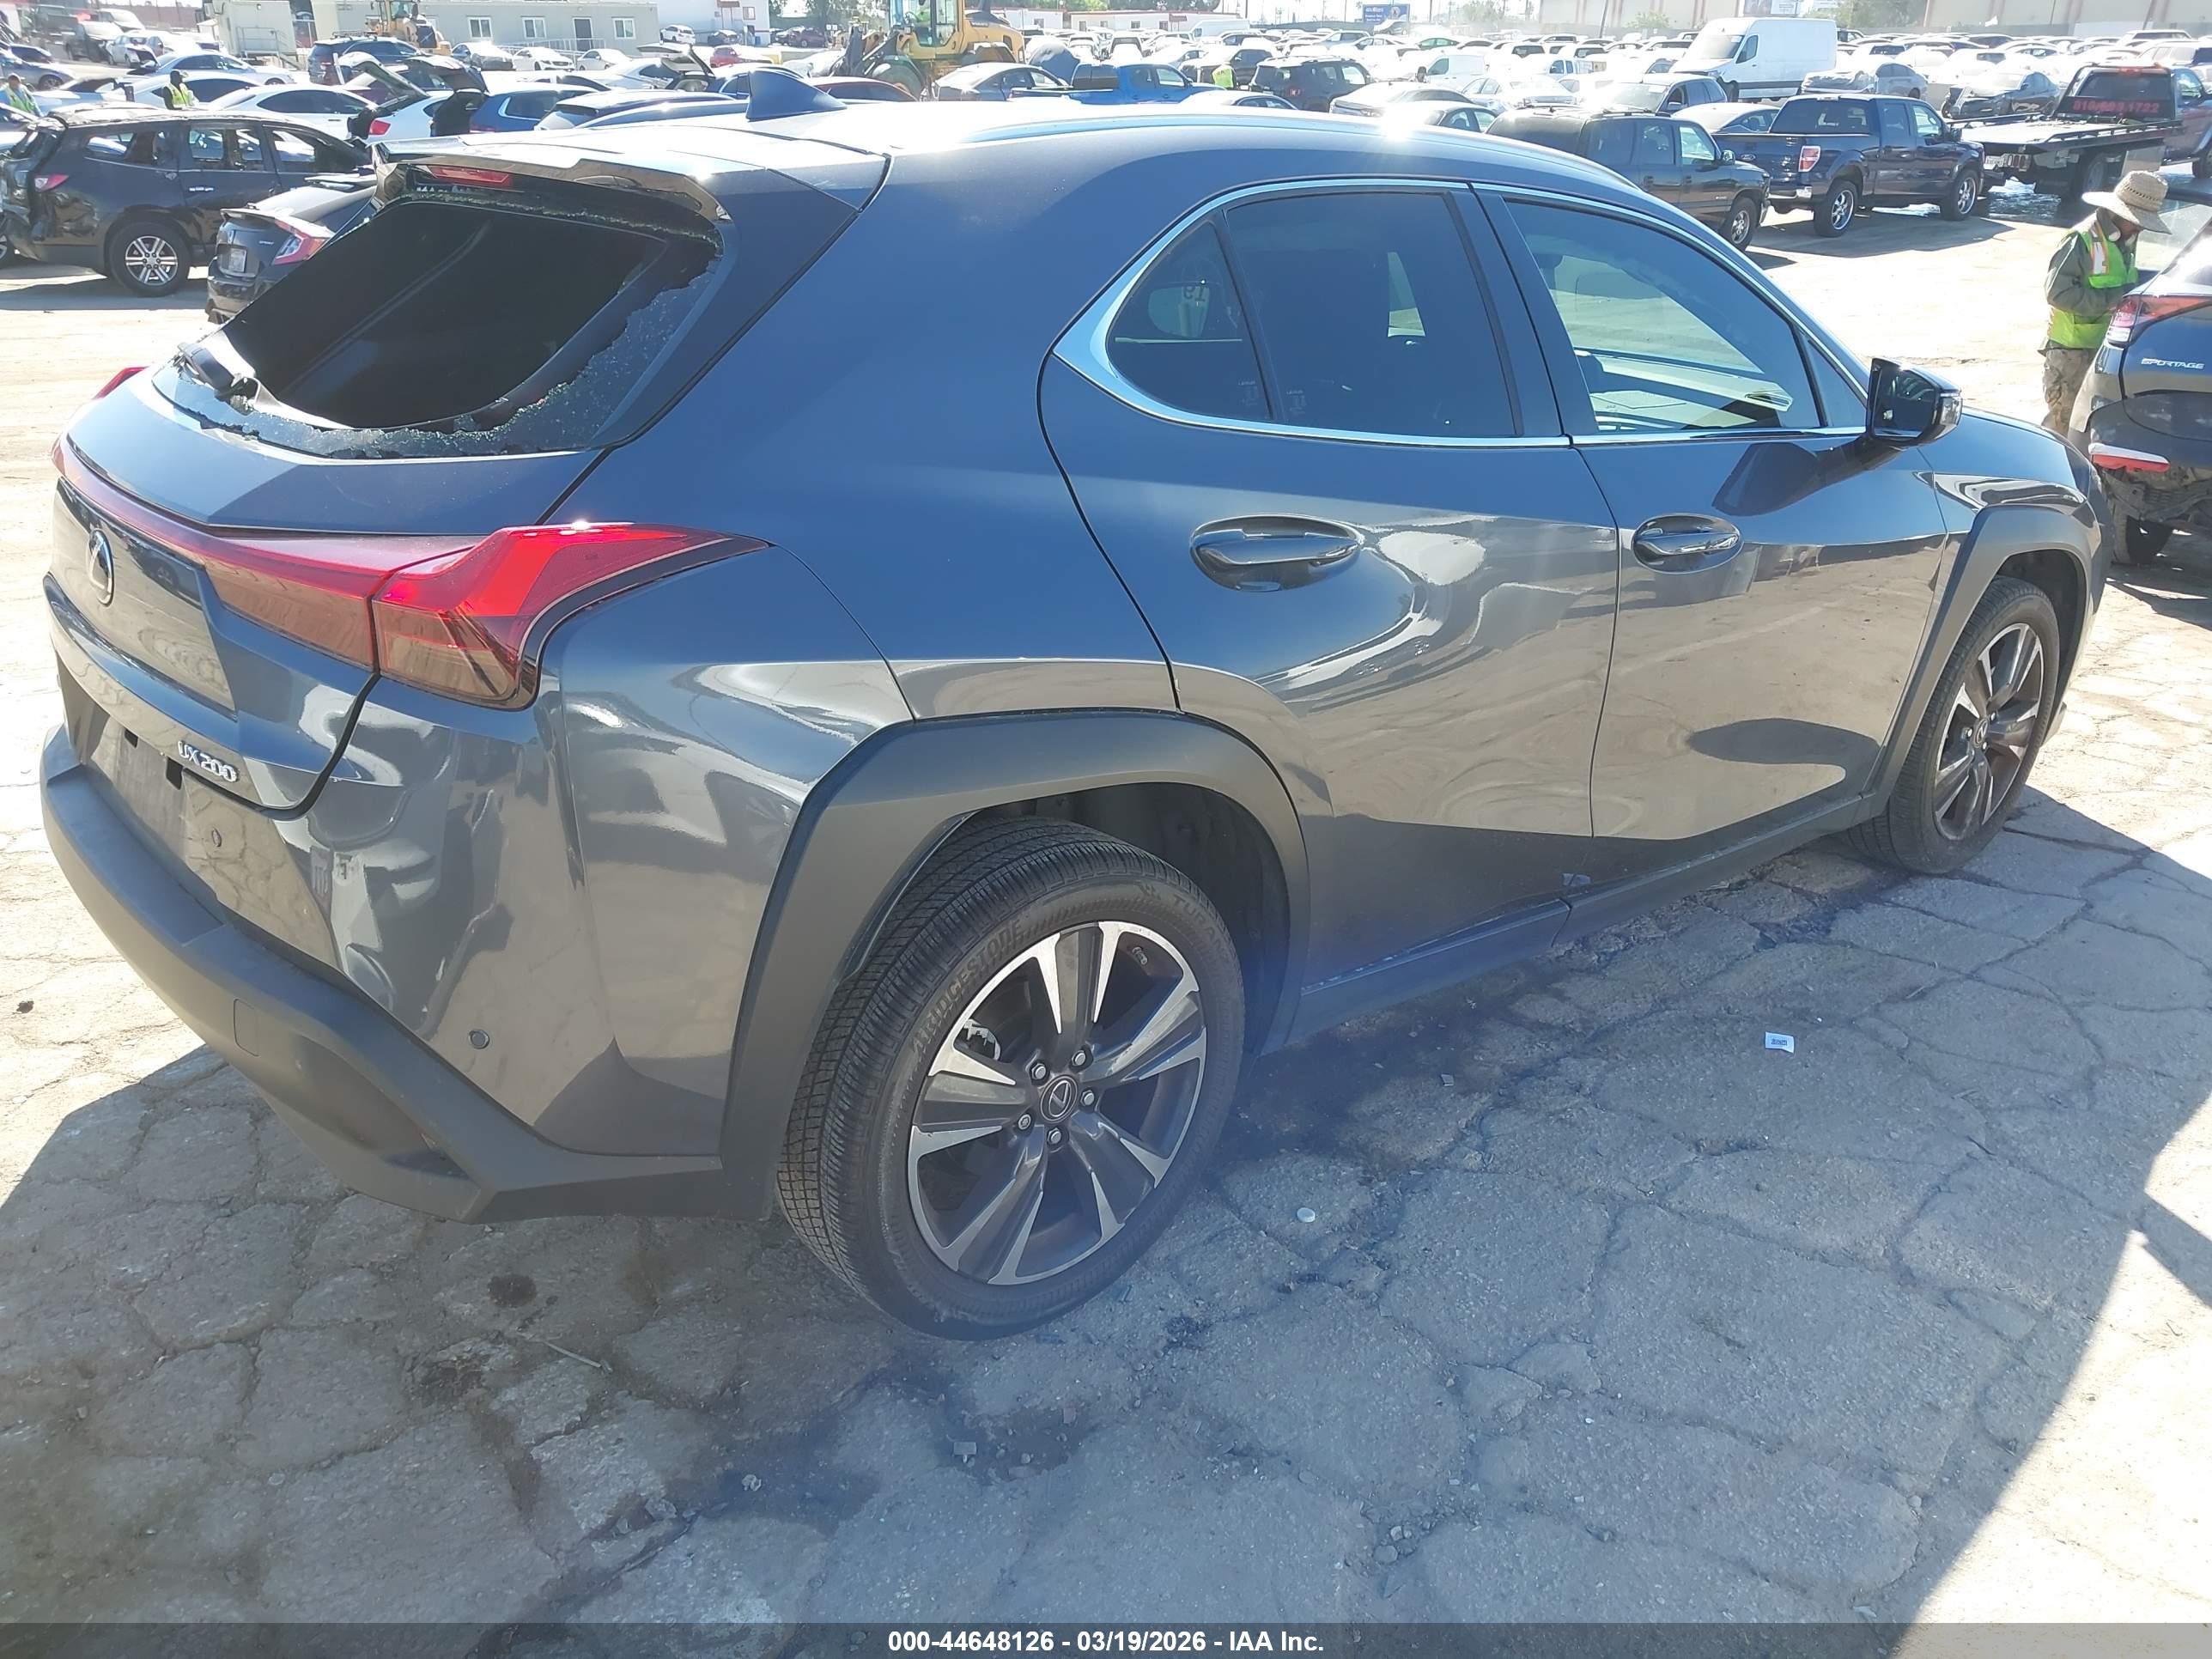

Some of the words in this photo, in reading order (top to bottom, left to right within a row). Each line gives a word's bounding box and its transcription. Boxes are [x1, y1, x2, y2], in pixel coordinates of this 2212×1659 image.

[2141, 357, 2205, 369] SPORTAGE
[177, 740, 200, 766] UX
[199, 752, 238, 782] 200
[912, 918, 1025, 1057] BRIDGESTONE
